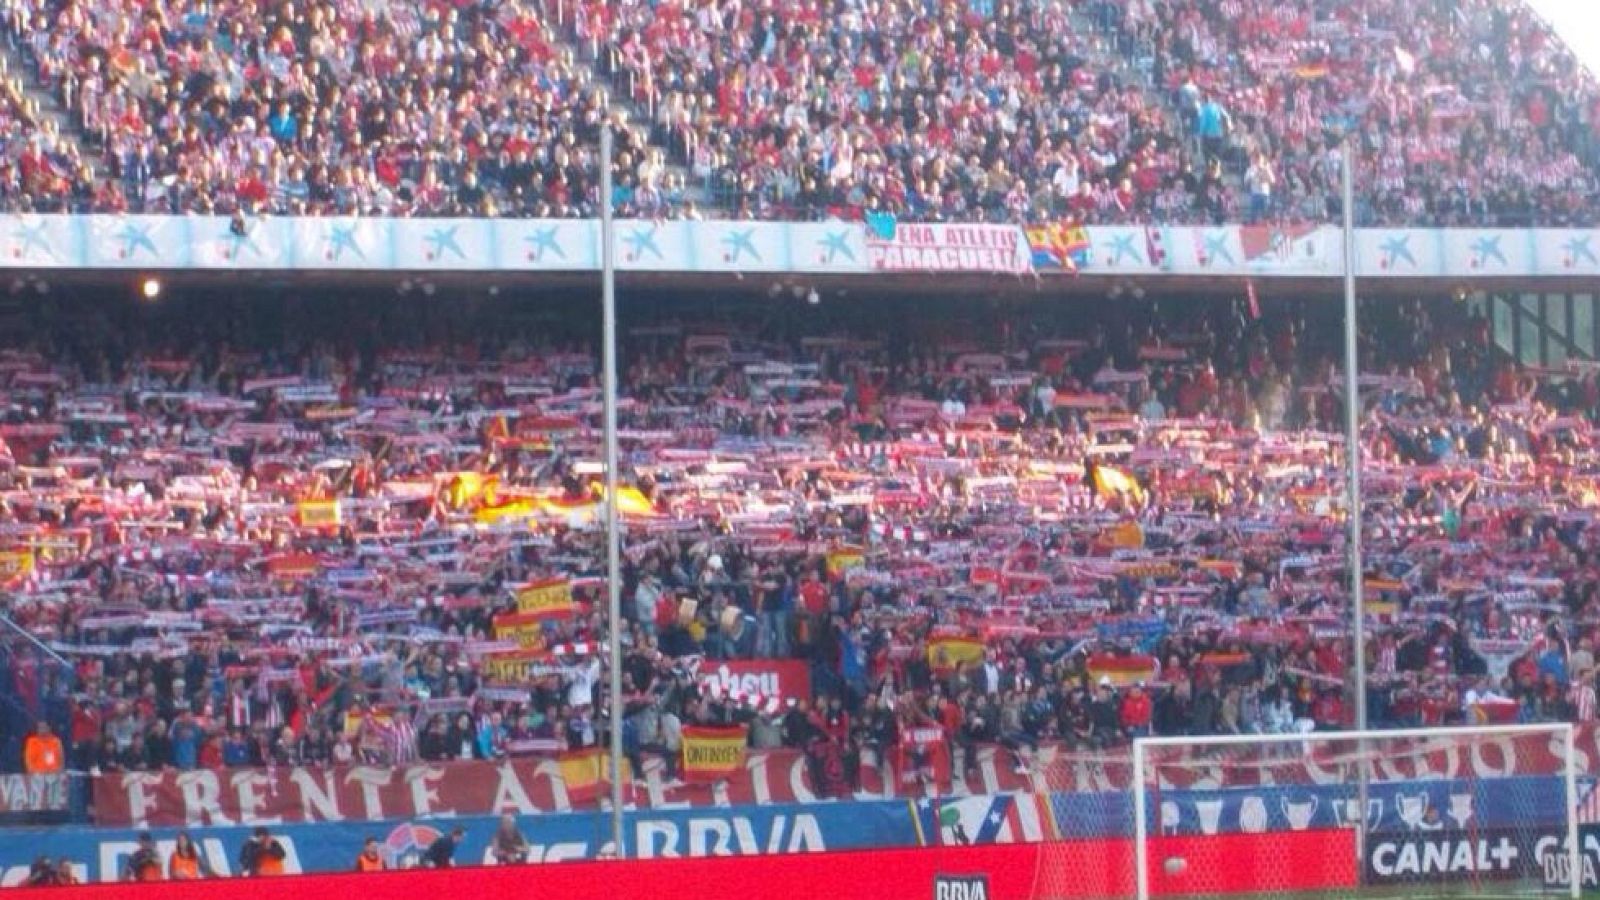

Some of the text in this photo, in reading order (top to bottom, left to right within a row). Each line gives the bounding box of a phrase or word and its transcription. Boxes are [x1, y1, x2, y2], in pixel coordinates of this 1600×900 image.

[122, 764, 447, 830] FRENTE
[635, 812, 826, 859] BBVA
[1372, 836, 1518, 876] CANAL+
[936, 880, 988, 900] BBVA
